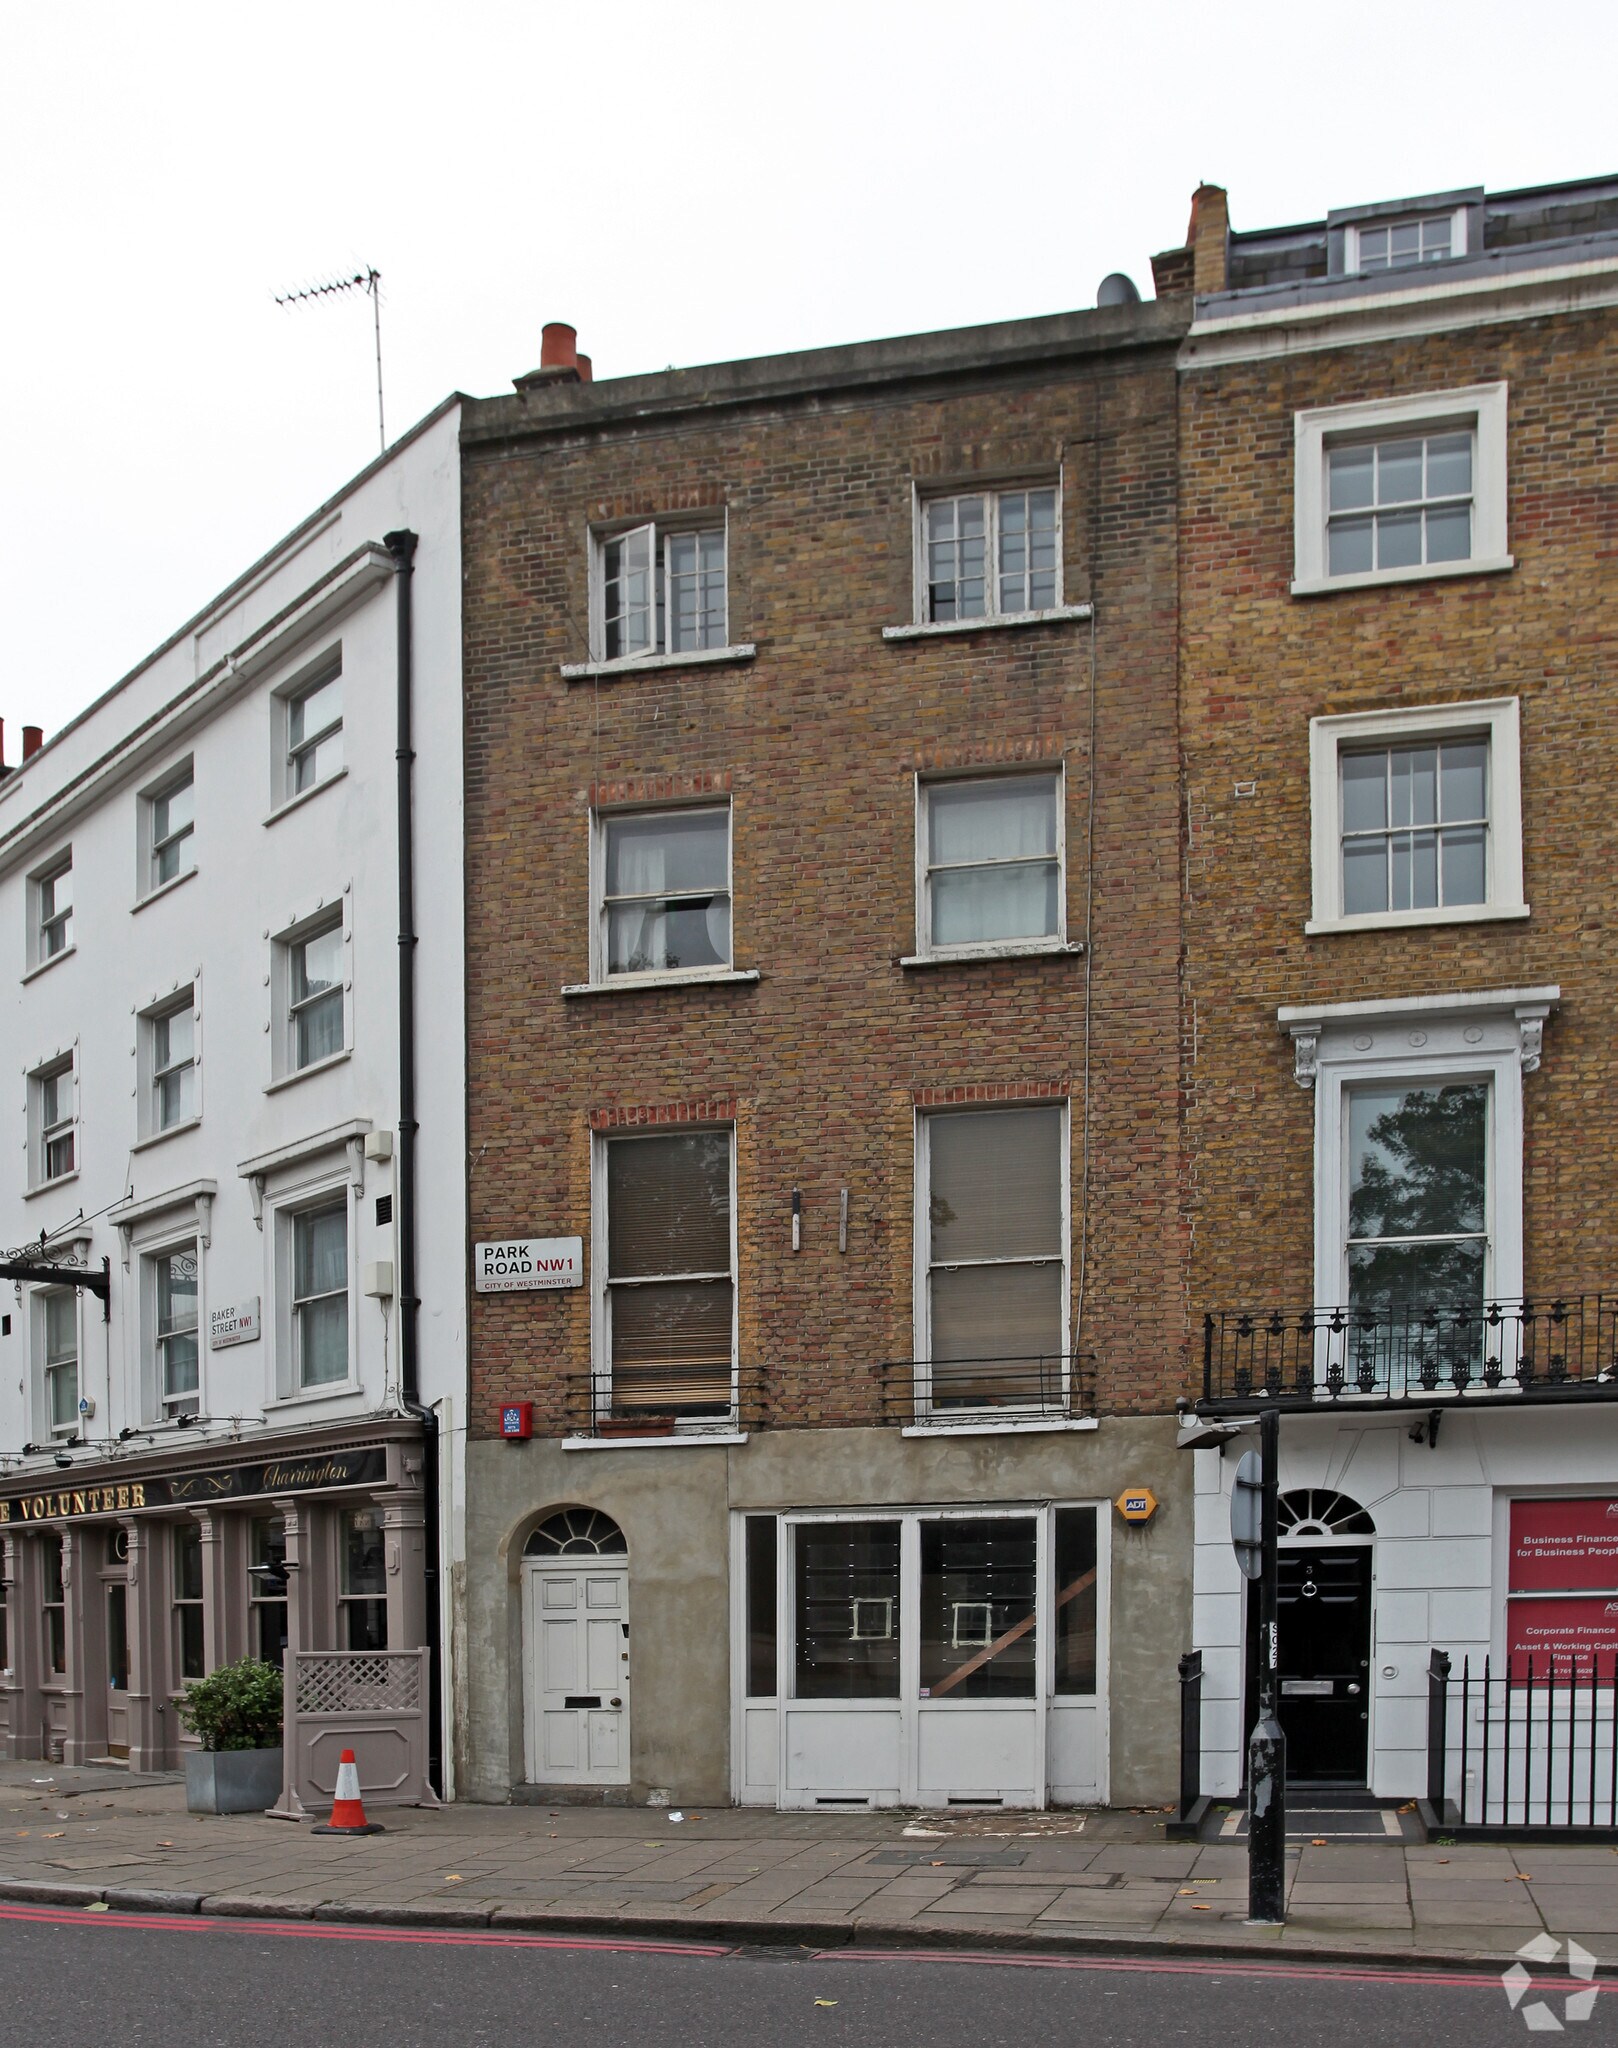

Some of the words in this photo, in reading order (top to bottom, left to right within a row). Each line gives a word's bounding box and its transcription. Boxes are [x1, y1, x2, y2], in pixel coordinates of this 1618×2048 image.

[484, 1245, 530, 1260] PARK
[484, 1261, 532, 1275] ROAD
[537, 1258, 573, 1272] NW1
[516, 1278, 572, 1287] WESTMINSTER
[211, 1307, 235, 1323] BAKER
[212, 1319, 238, 1335] STREET
[239, 1315, 252, 1328] NW1
[263, 1461, 348, 1490] Charrington
[20, 1483, 146, 1520] VOLUNTEER
[1126, 1500, 1147, 1509] ADT
[1523, 1536, 1574, 1545] Business
[1576, 1535, 1618, 1544] Finance
[1517, 1549, 1532, 1557] for
[1535, 1548, 1585, 1557] Business
[1306, 1566, 1314, 1575] 3
[1526, 1627, 1575, 1636] Corporate
[1577, 1626, 1616, 1634] Finance
[1553, 1643, 1592, 1651] Working
